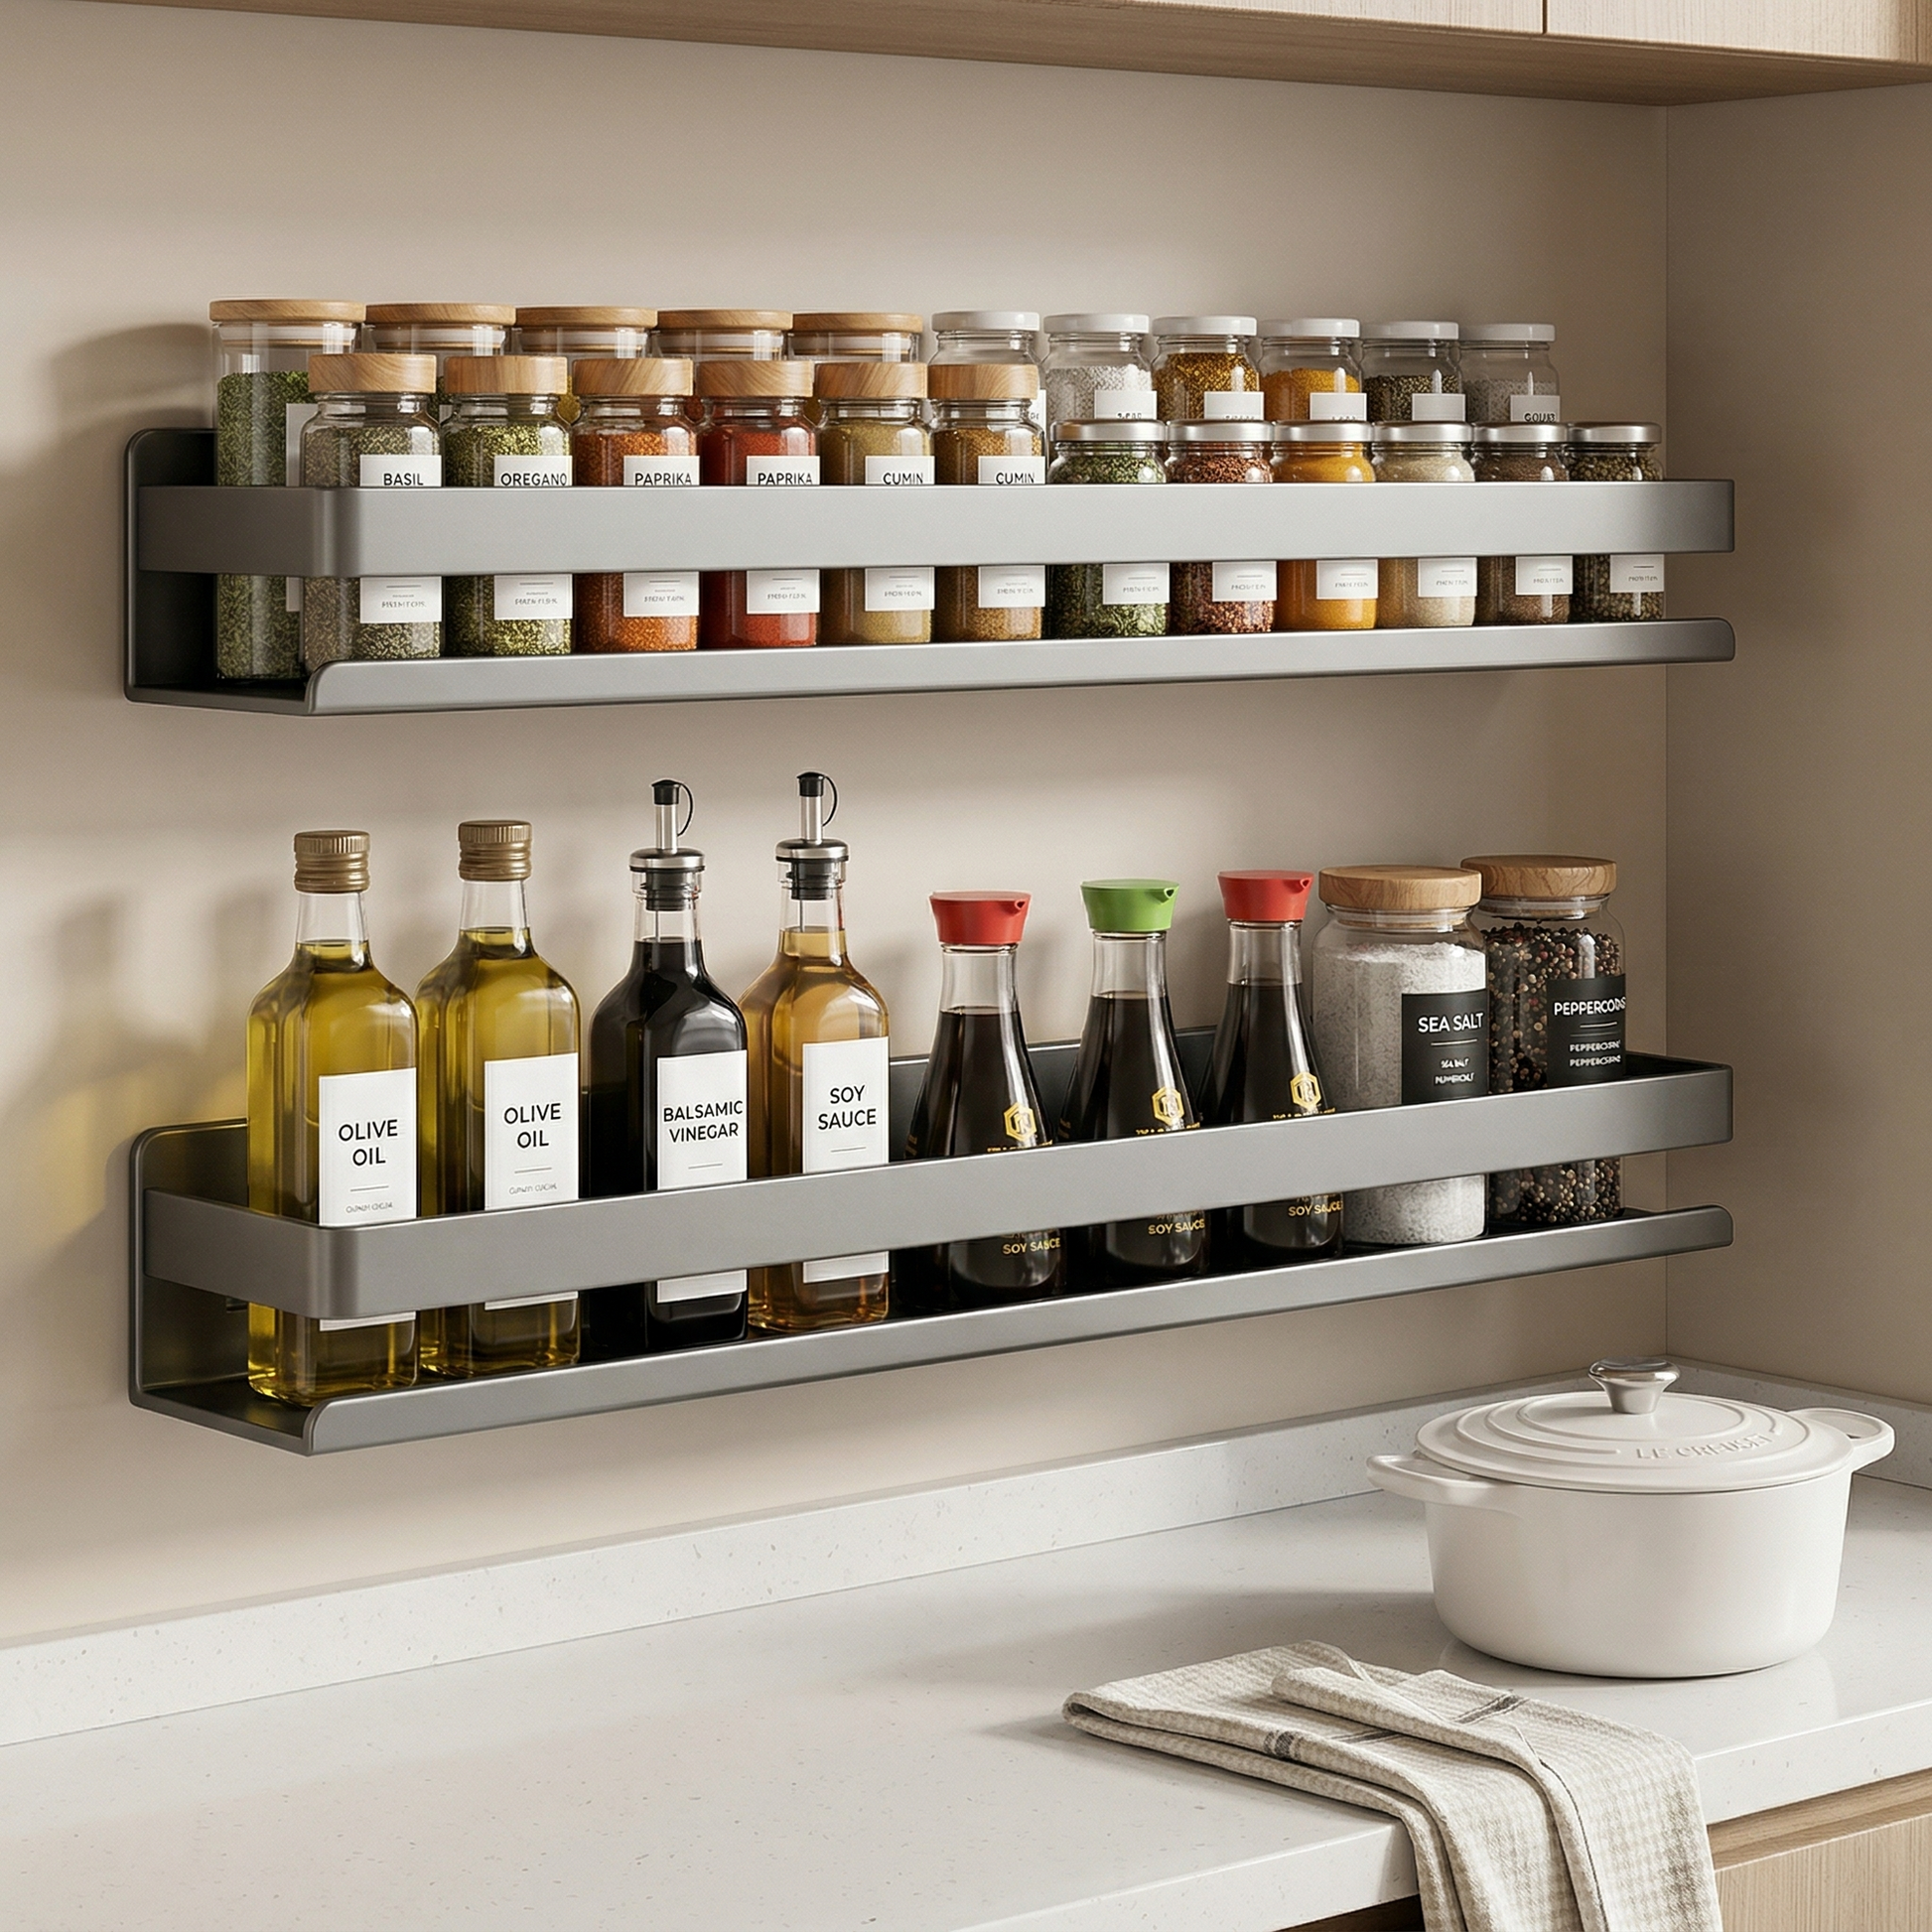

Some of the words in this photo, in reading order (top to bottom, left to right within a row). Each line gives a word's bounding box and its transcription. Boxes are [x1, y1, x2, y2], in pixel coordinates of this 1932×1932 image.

[383, 473, 424, 486] BASIL
[500, 472, 568, 486] OREGANO
[634, 472, 692, 485] PAPRIKA
[758, 472, 813, 485] PAPRIKA
[883, 472, 924, 484] CUMIN
[995, 472, 1035, 484] CUMIN
[1418, 1016, 1450, 1034] SEA
[1452, 1012, 1484, 1032] SALT
[829, 1084, 866, 1105] SOY
[503, 1102, 562, 1125] OLIVE
[663, 1100, 744, 1123] BALSAMIC
[818, 1108, 877, 1130] SAUCE
[339, 1119, 398, 1142] OLIVE
[669, 1122, 739, 1143] VINEGAR
[516, 1130, 549, 1149] OIL
[352, 1147, 386, 1167] OIL
[1288, 1204, 1312, 1217] SOY
[1148, 1222, 1173, 1235] SOY
[1002, 1242, 1027, 1255] SOY
[1635, 1448, 1670, 1459] LE
